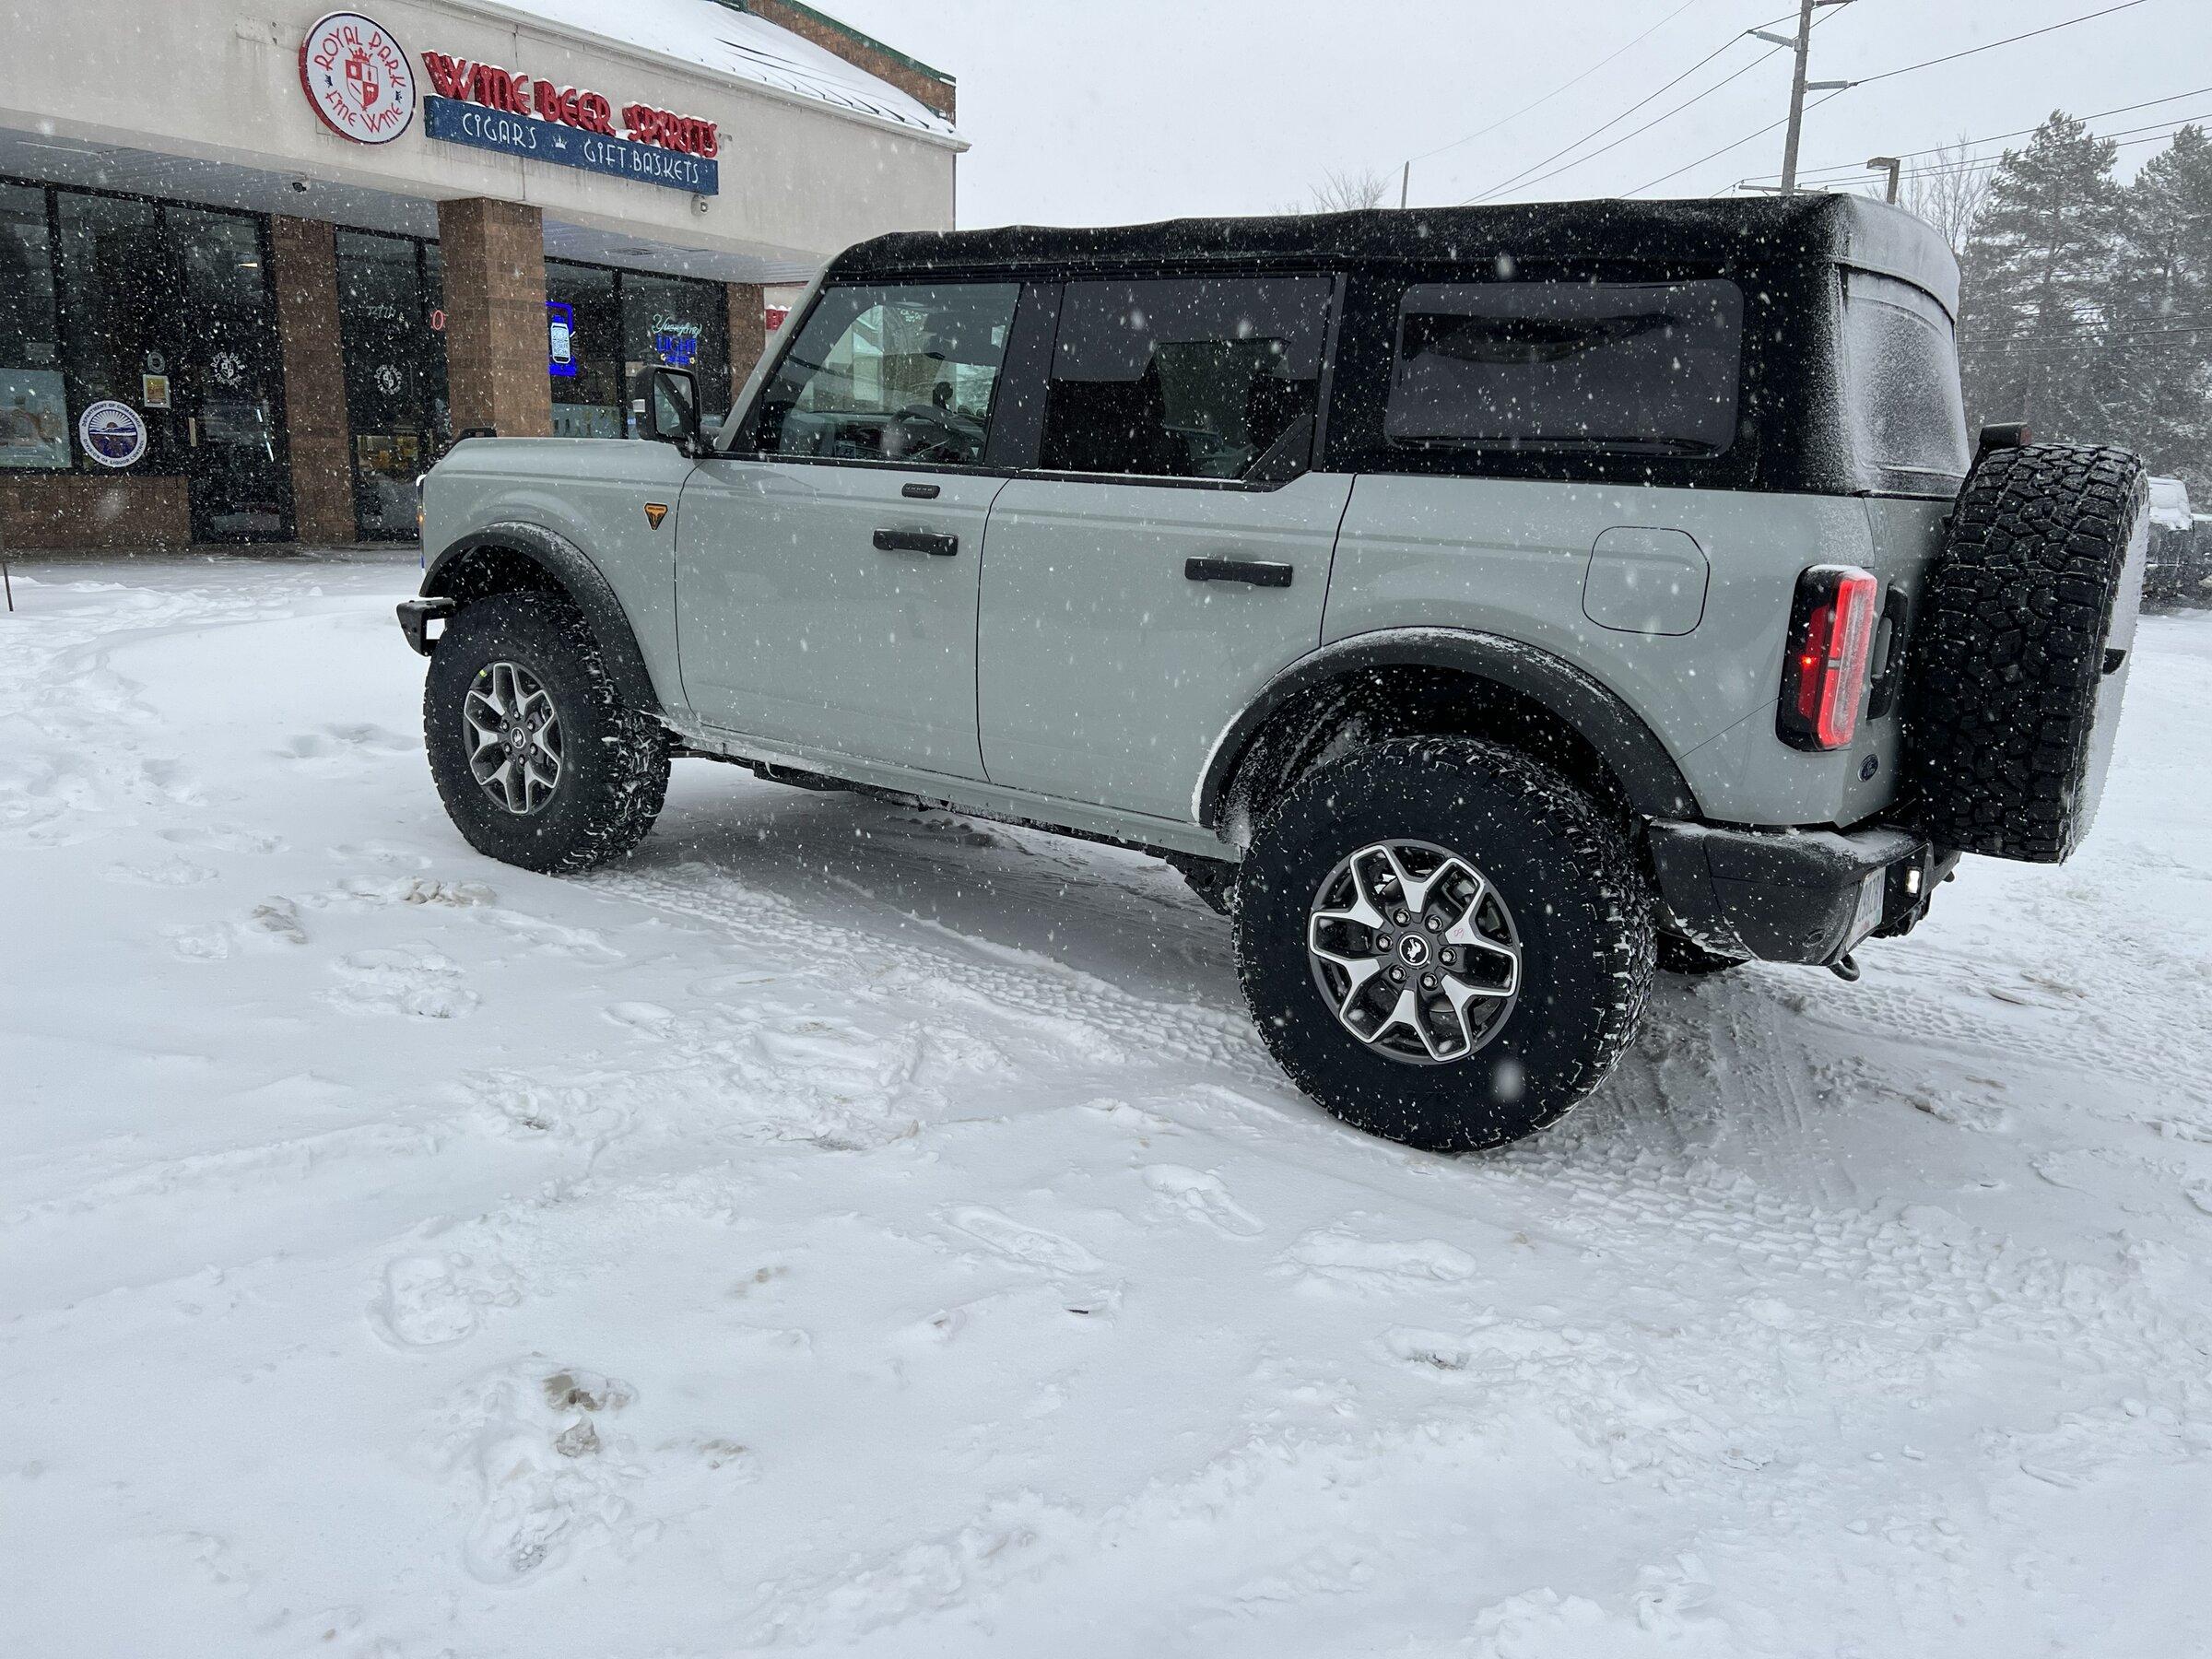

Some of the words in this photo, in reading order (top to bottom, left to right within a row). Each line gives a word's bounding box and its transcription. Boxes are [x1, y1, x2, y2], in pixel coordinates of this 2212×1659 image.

[314, 26, 362, 71] ROYAL
[369, 31, 406, 88] PARK
[324, 89, 358, 127] FINE
[359, 102, 404, 134] WINE
[421, 51, 531, 116] WINE
[533, 80, 616, 137] BEER
[622, 103, 718, 159] SPIRITS
[462, 112, 537, 149] CIGARS
[583, 138, 627, 169] GIFT
[632, 150, 700, 184] BASKETS
[81, 403, 107, 427] DEPARTMENT
[116, 404, 143, 428] COMMERCE
[83, 439, 100, 459] DIVISION
